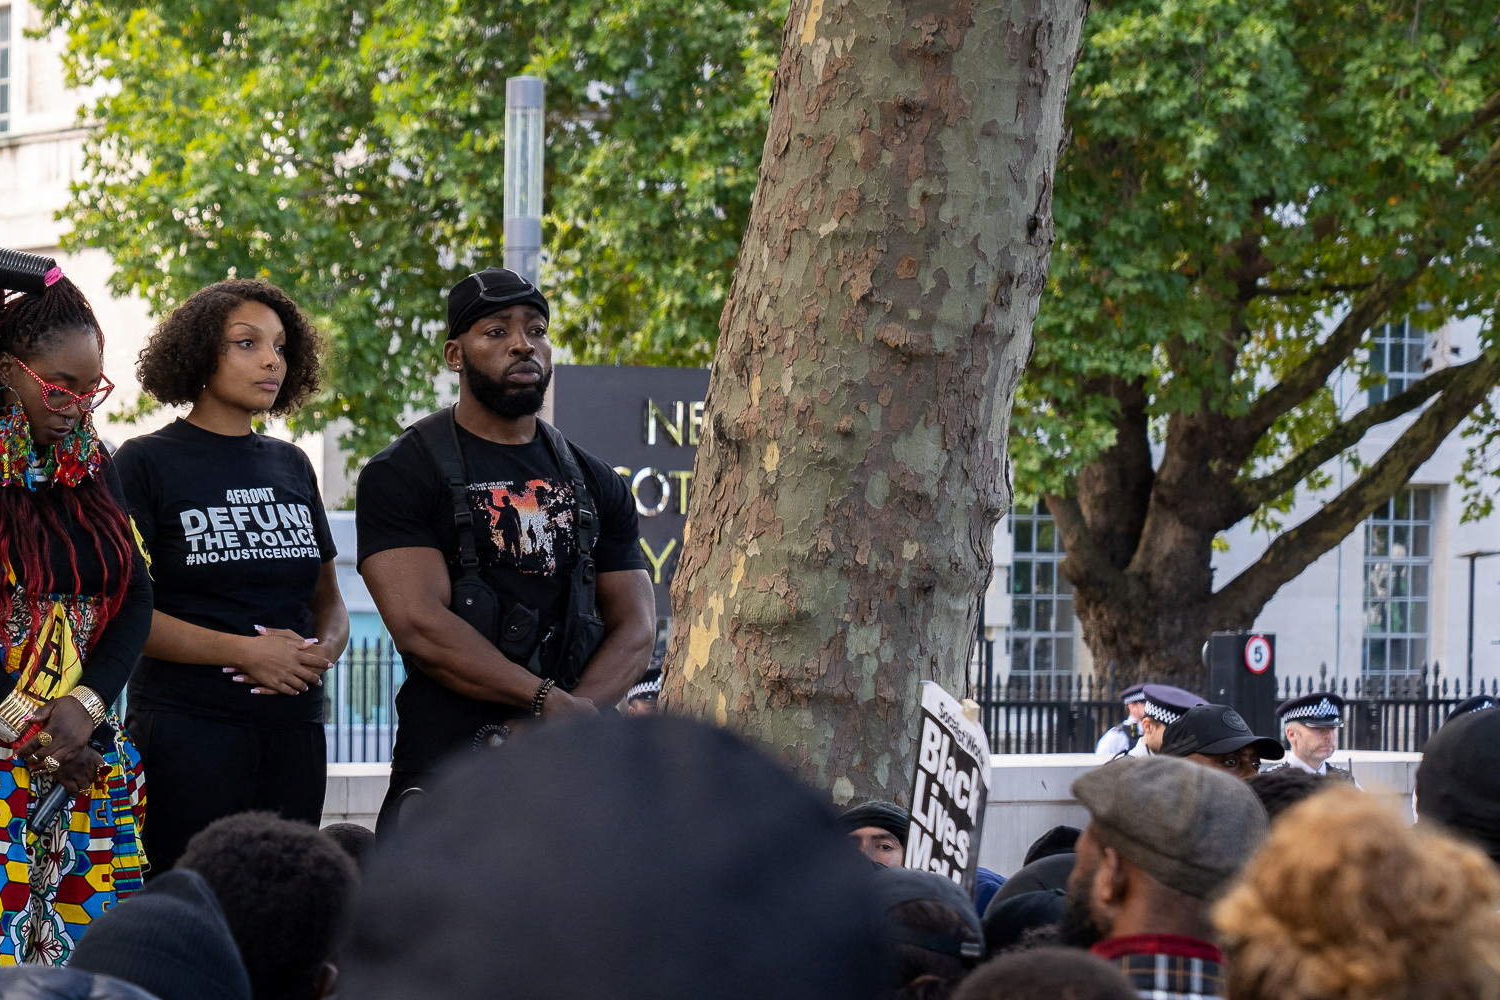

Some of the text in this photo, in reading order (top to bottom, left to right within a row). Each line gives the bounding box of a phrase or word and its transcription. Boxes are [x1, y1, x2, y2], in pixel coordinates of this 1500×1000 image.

[647, 398, 705, 447] NE
[226, 487, 276, 504] 4FRONT
[179, 503, 313, 536] DEFUND
[186, 528, 318, 552] THE POLICE
[1254, 646, 1263, 664] 5
[919, 716, 980, 827] Black
[911, 768, 970, 870] Lives
